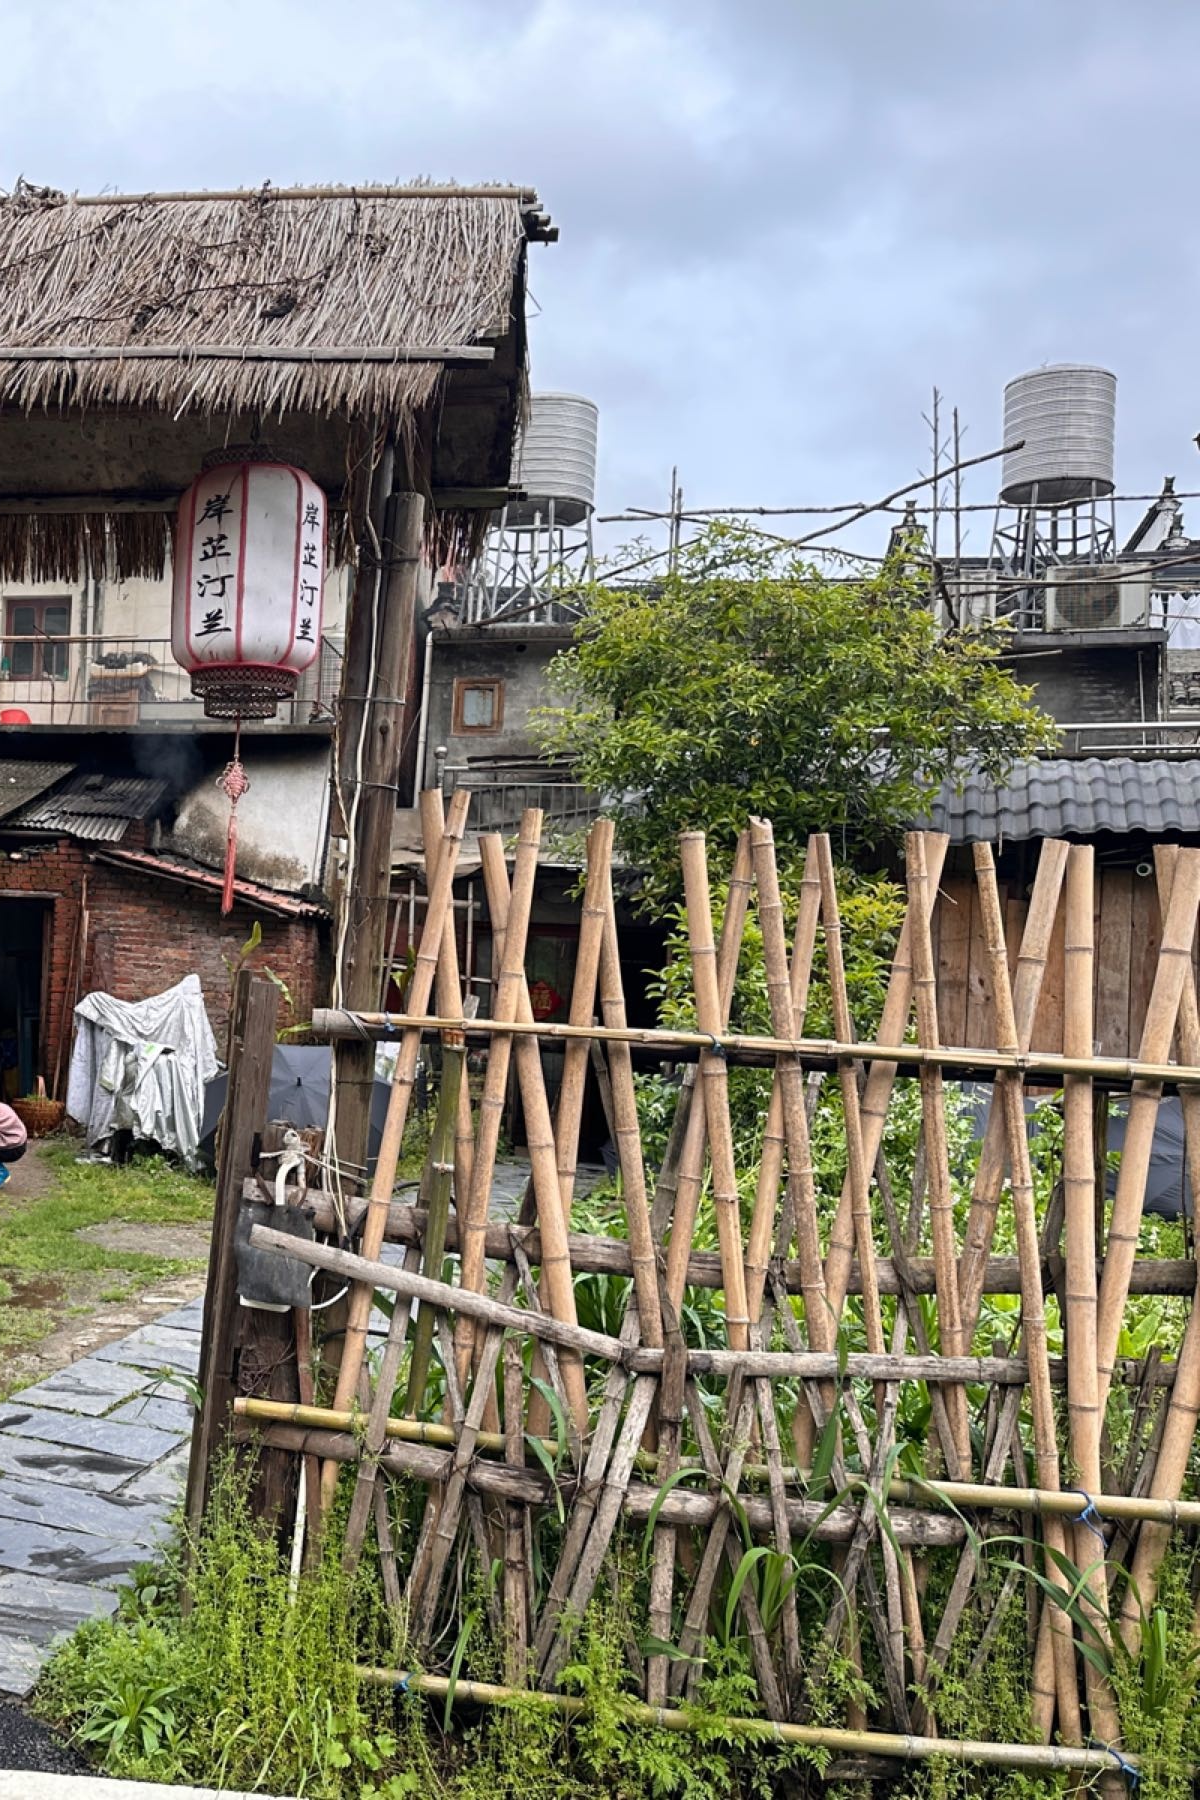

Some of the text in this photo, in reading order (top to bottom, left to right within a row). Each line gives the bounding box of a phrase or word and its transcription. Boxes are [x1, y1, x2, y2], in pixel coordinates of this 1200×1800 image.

[196, 494, 234, 637] 岸芷汀兰
[296, 502, 320, 643] 岸芷汀兰
